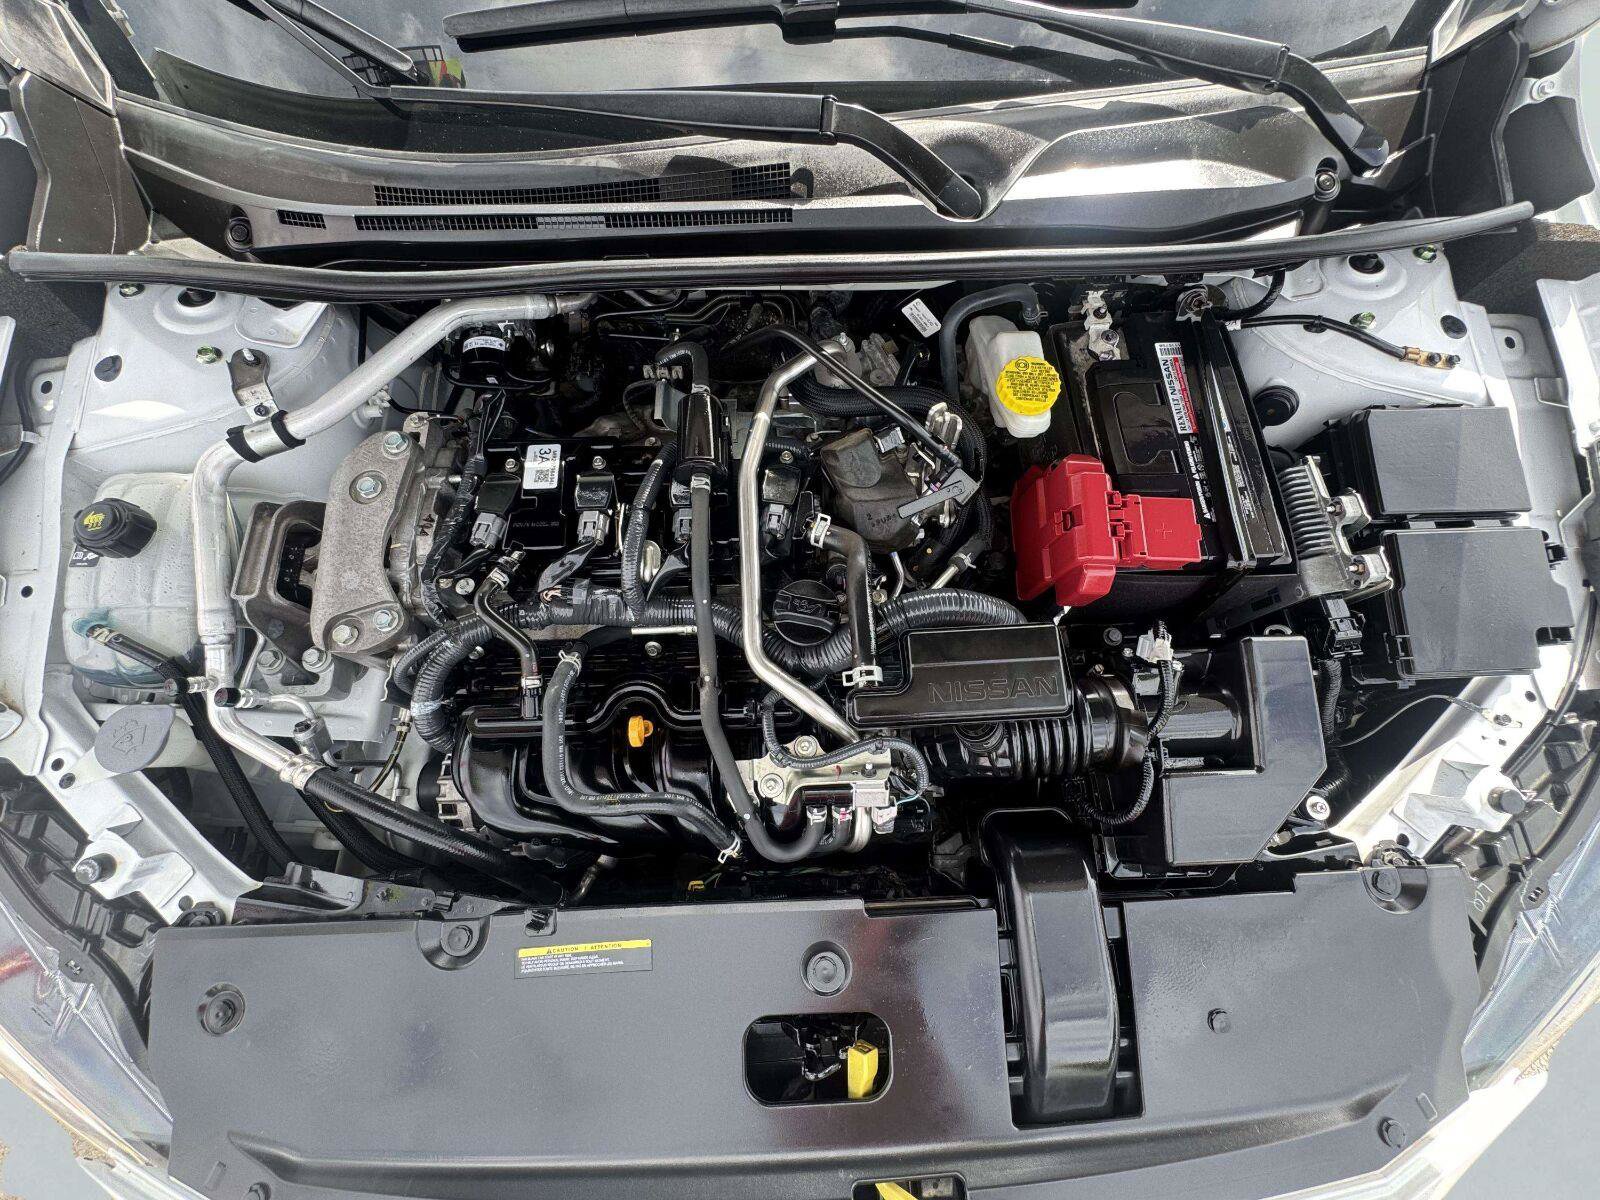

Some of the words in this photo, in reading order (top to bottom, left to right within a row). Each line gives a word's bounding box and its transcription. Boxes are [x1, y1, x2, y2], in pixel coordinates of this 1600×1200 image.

[1162, 359, 1177, 395] NISSAN
[1172, 398, 1187, 432] RENAULT
[538, 448, 551, 465] 3A
[928, 675, 1060, 703] NISSAN
[552, 946, 579, 954] CAUTION
[590, 943, 622, 951] ATTENTION
